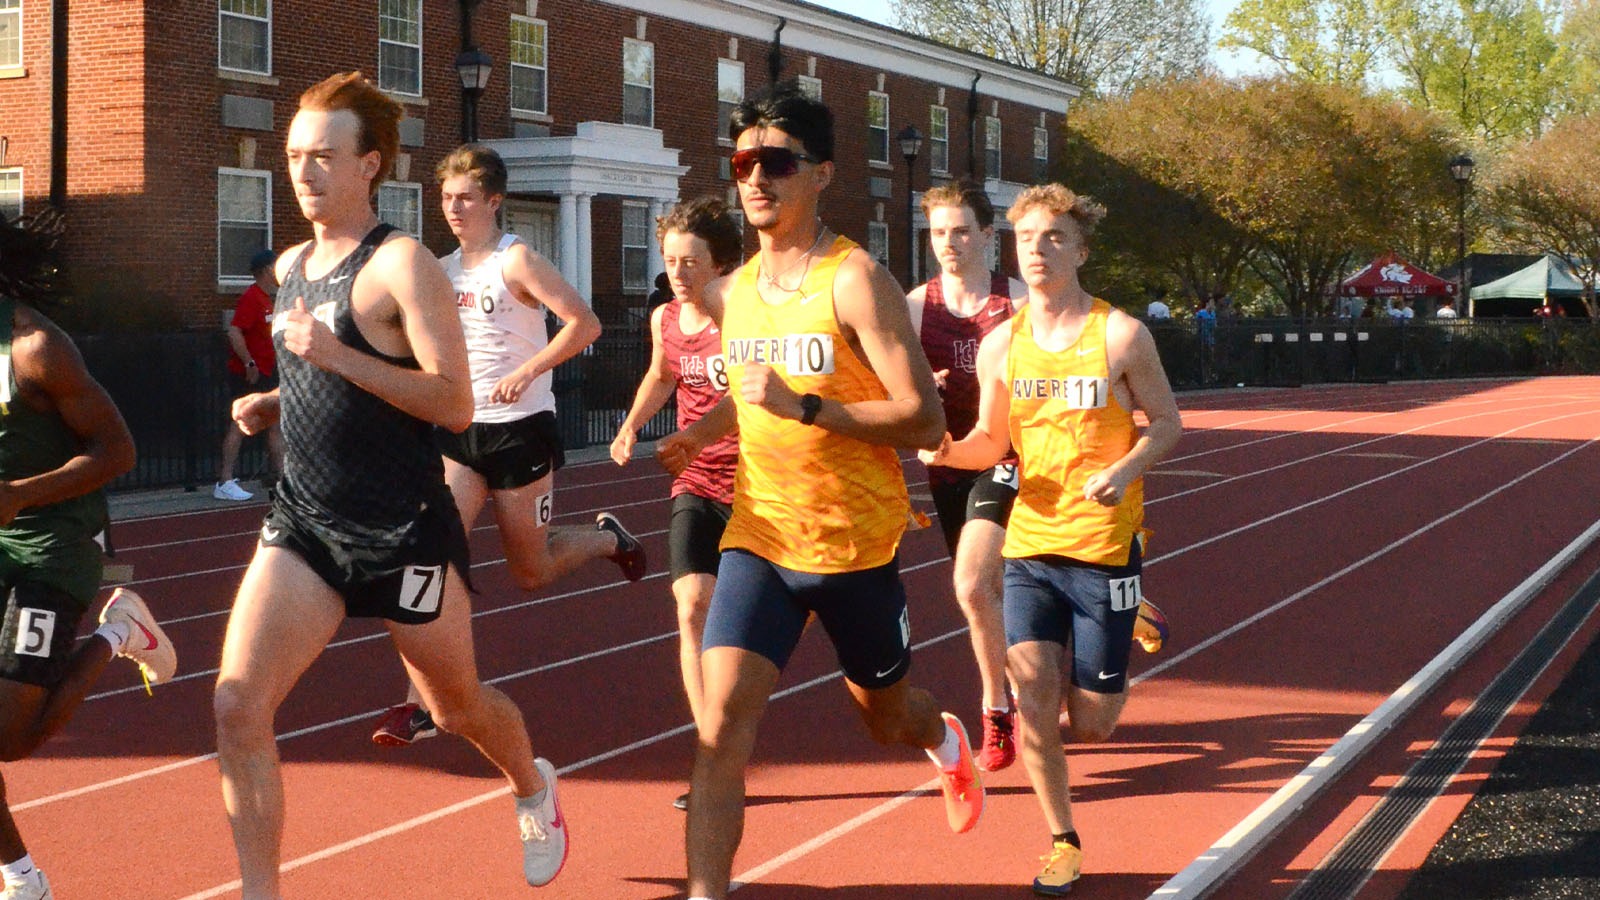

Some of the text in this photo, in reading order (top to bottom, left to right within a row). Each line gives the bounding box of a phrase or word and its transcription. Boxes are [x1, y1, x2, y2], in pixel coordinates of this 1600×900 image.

[481, 284, 494, 314] 6
[794, 337, 825, 373] 10
[712, 357, 729, 387] 8
[1074, 379, 1098, 407] 11
[540, 495, 550, 523] 6
[410, 568, 435, 609] 7
[1117, 578, 1137, 609] 11
[25, 611, 47, 653] 5
